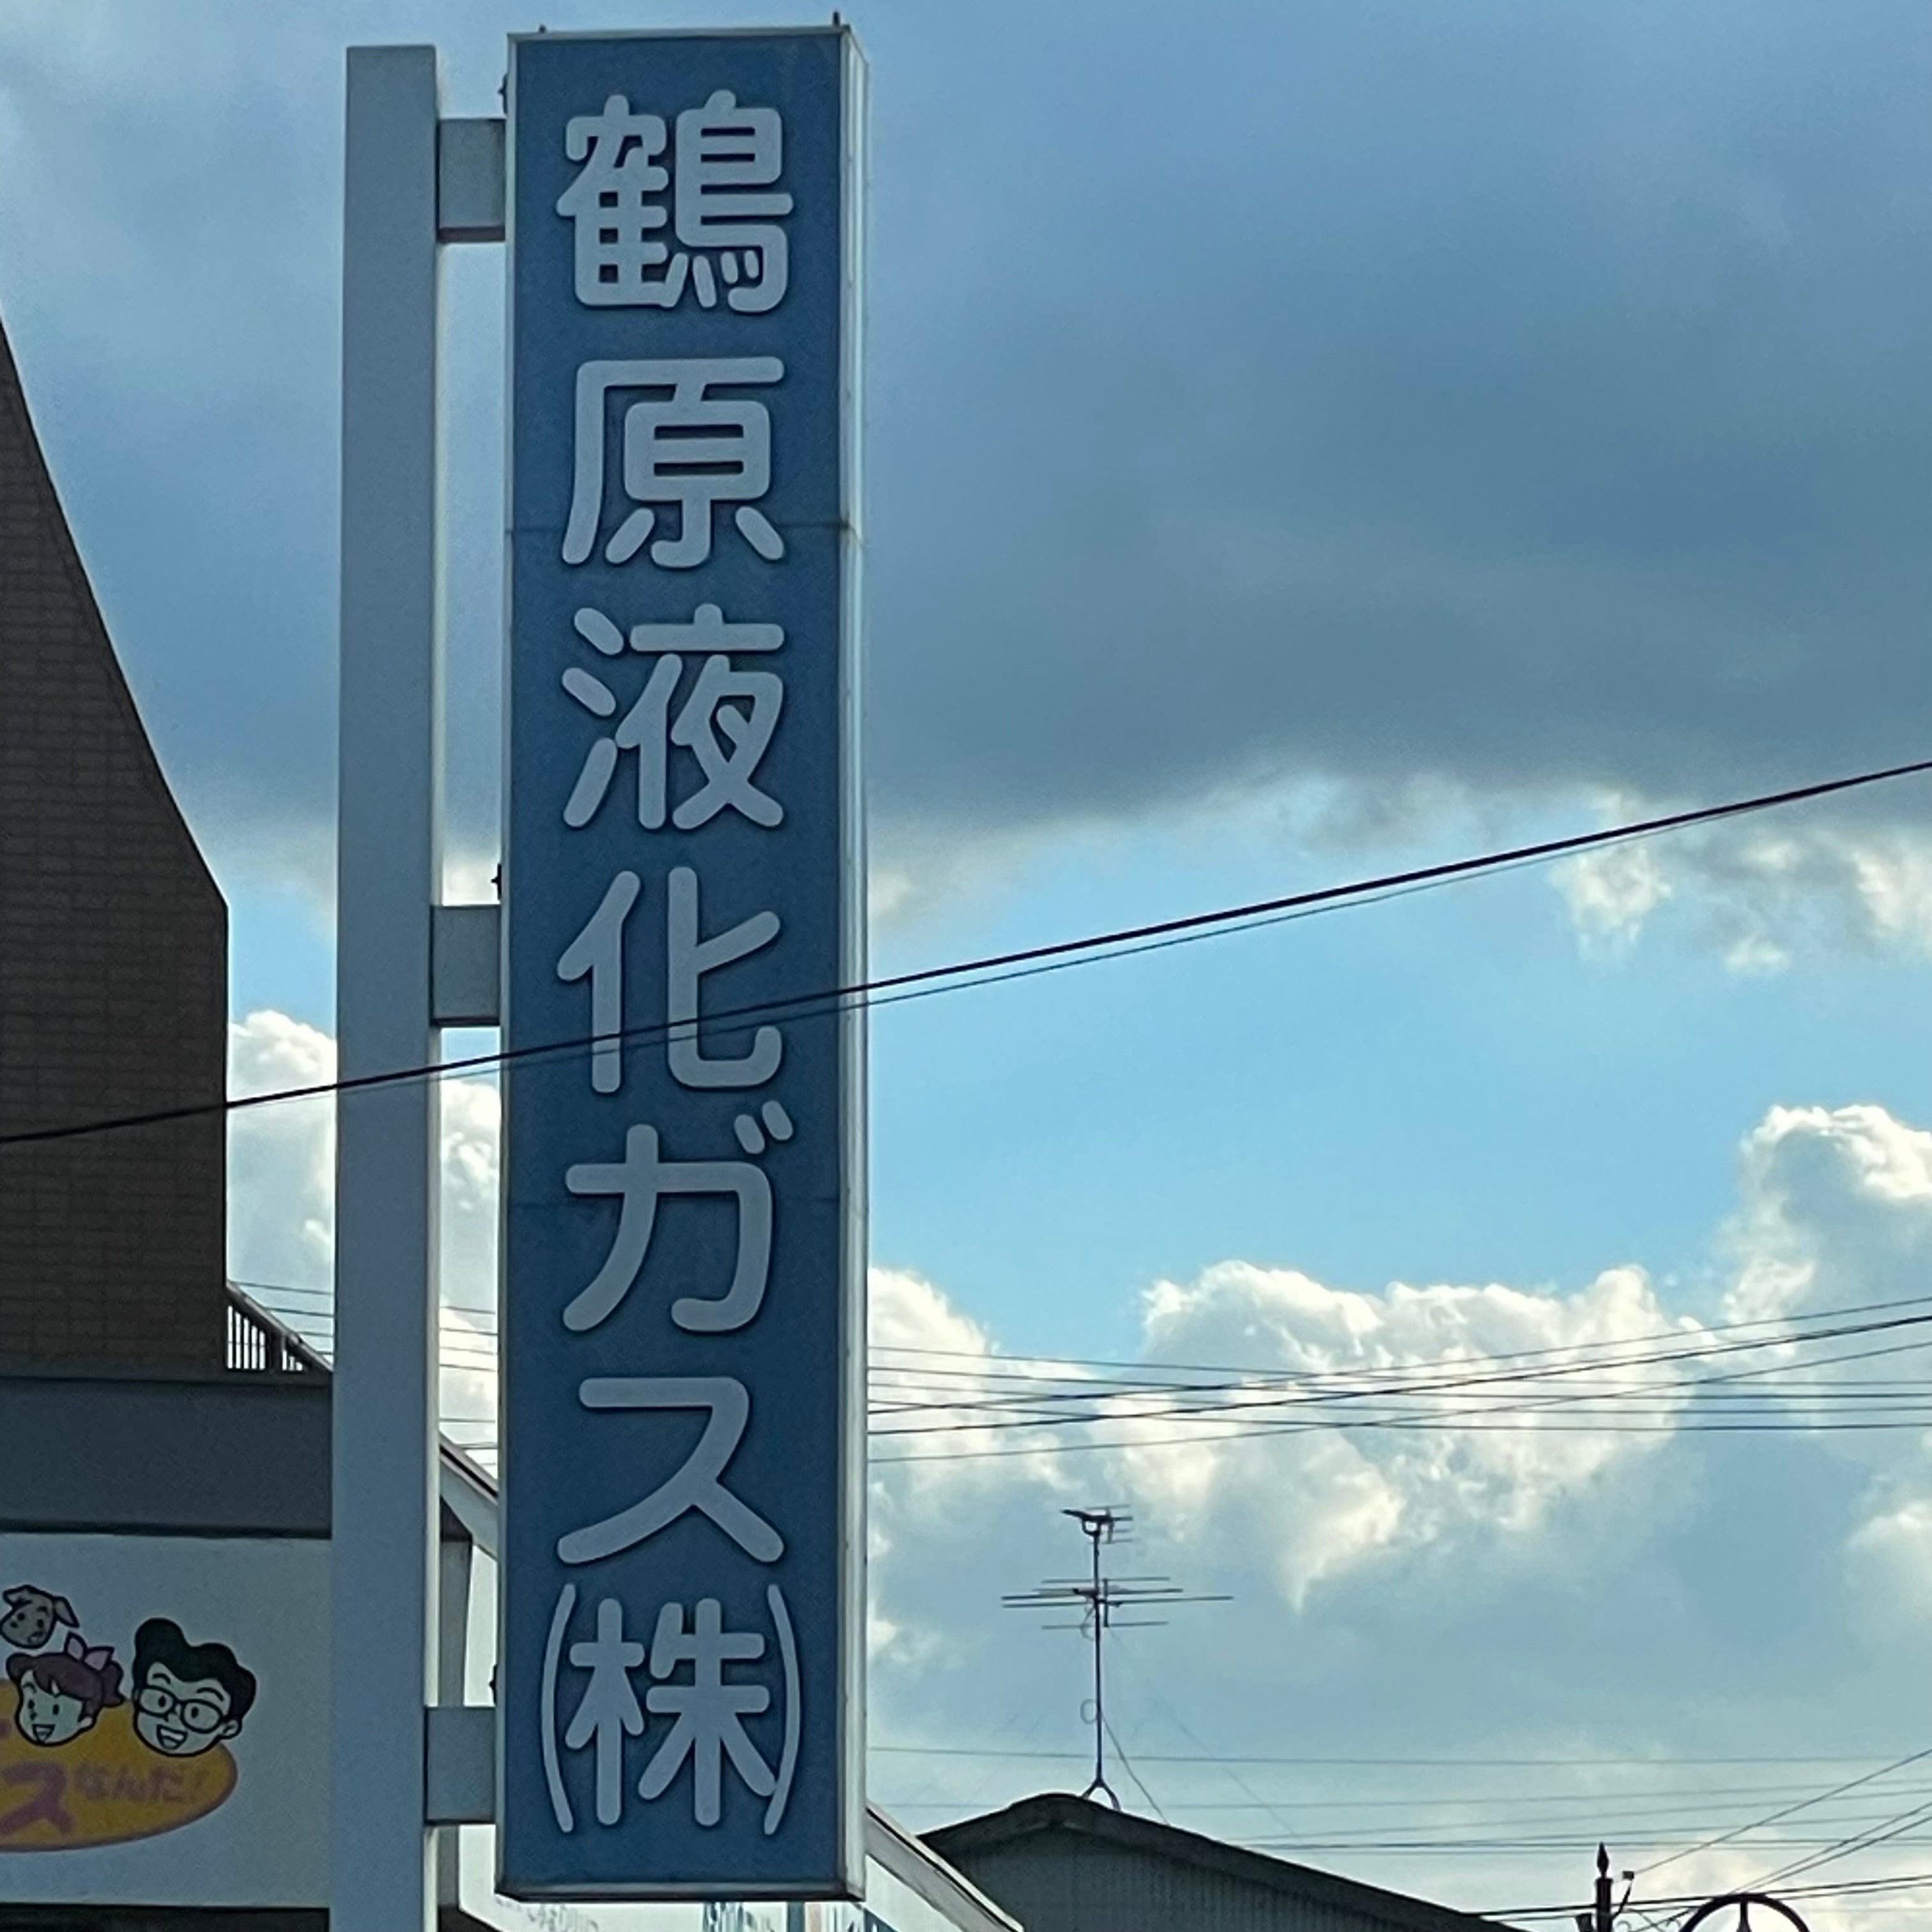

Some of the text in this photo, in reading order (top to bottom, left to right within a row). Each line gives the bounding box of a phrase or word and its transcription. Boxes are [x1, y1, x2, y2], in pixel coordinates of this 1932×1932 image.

[541, 89, 801, 1836] 鶴原液化ガス(株)
